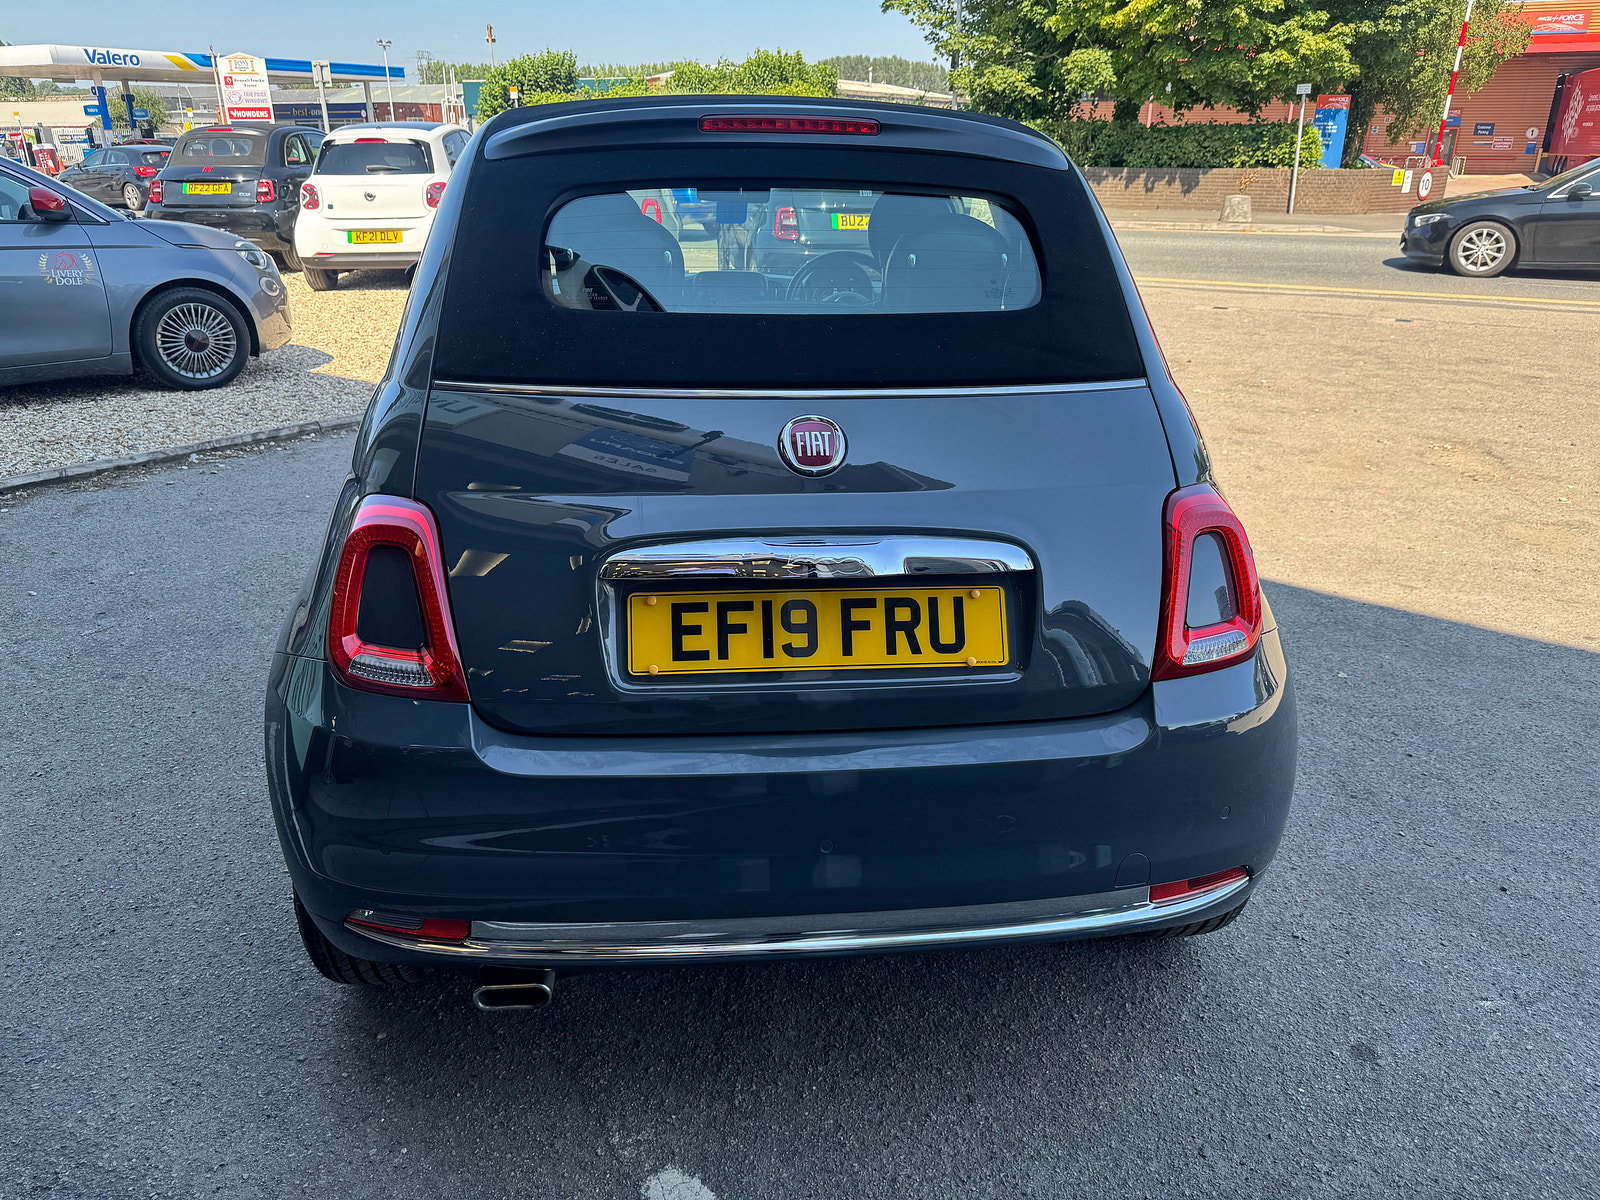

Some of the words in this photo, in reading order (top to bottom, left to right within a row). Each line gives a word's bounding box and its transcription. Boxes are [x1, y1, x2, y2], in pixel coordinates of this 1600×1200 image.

[83, 48, 140, 66] Valero
[237, 110, 269, 118] HOWDENS
[188, 183, 210, 193] RF22
[212, 183, 229, 192] GFA
[1421, 178, 1431, 191] 10
[355, 231, 378, 242] KF21
[380, 230, 399, 241] DLV
[51, 268, 84, 278] LIVERY
[55, 277, 83, 286] DOLE
[795, 431, 832, 457] FIAT
[671, 598, 819, 662] EF19
[840, 596, 966, 657] FRU
